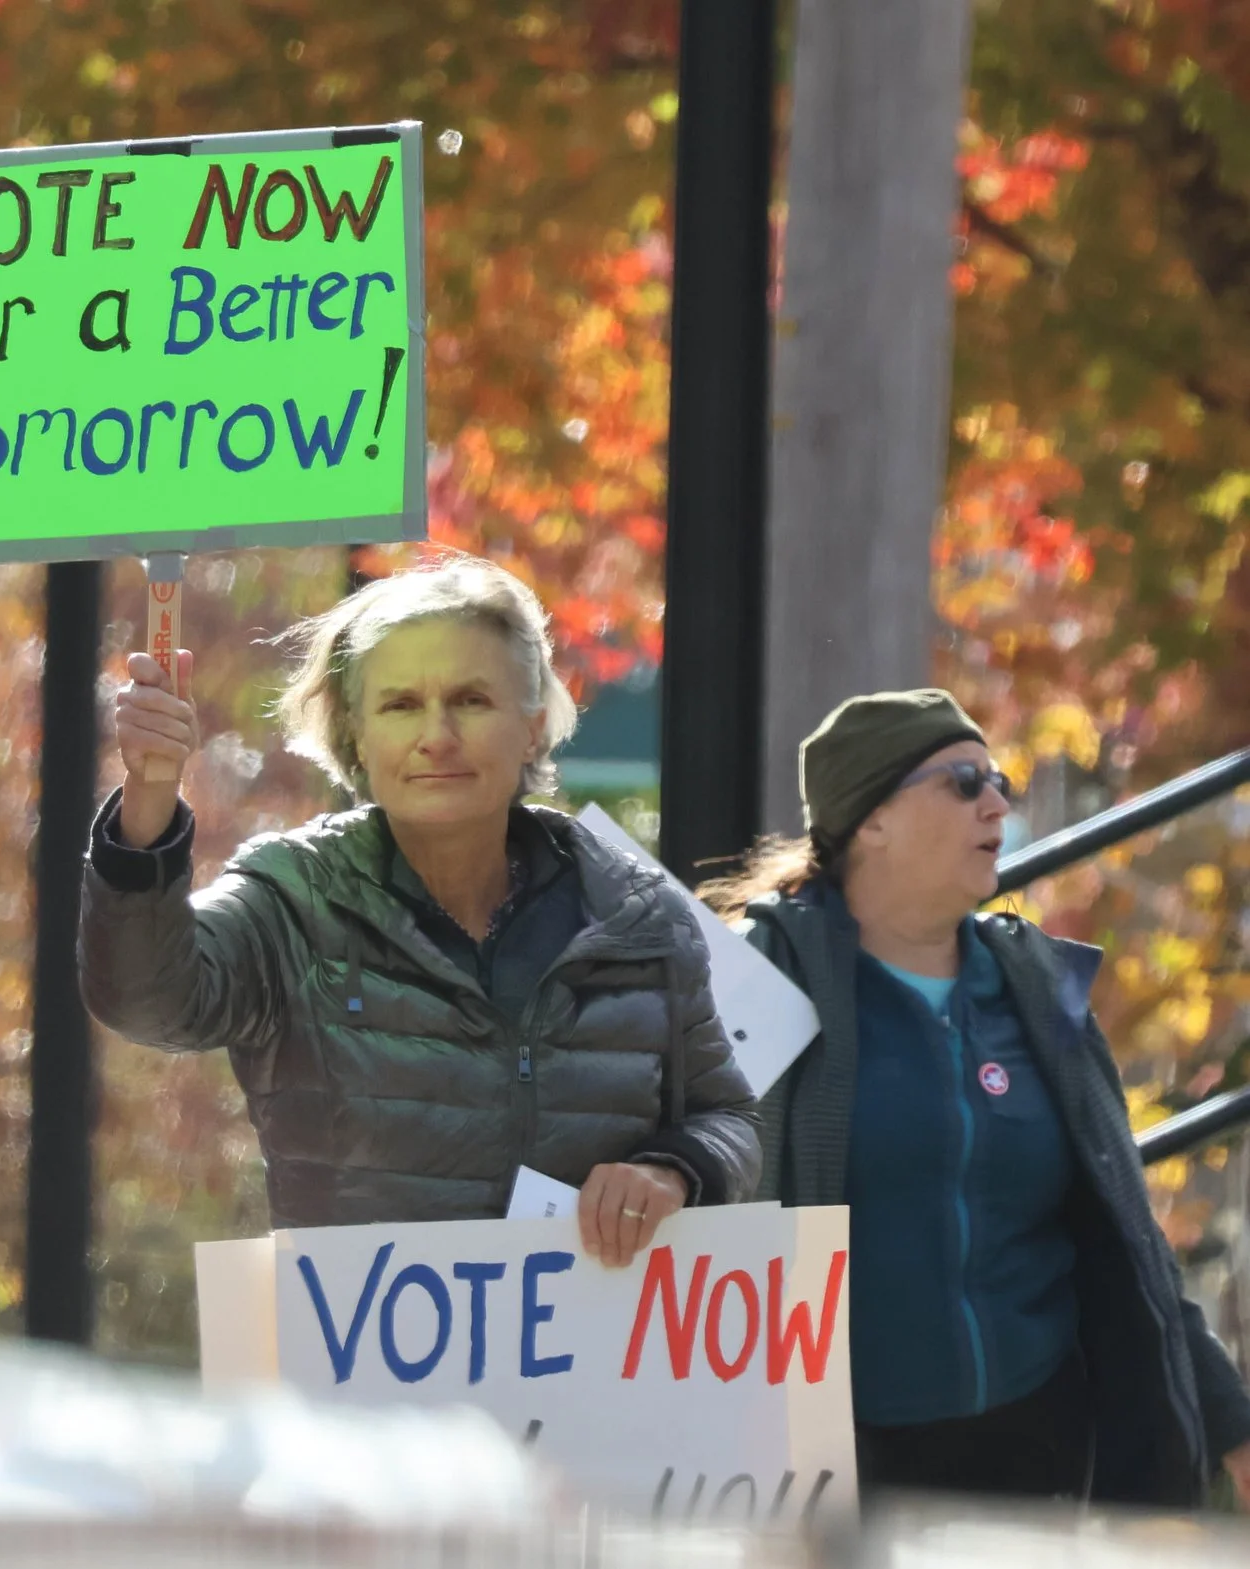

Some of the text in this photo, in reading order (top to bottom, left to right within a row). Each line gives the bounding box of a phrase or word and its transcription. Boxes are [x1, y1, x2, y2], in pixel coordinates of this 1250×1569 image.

[182, 156, 394, 250] NOW
[79, 288, 132, 354] a
[164, 265, 396, 356] Better
[296, 1241, 848, 1386] VOTE NOW
